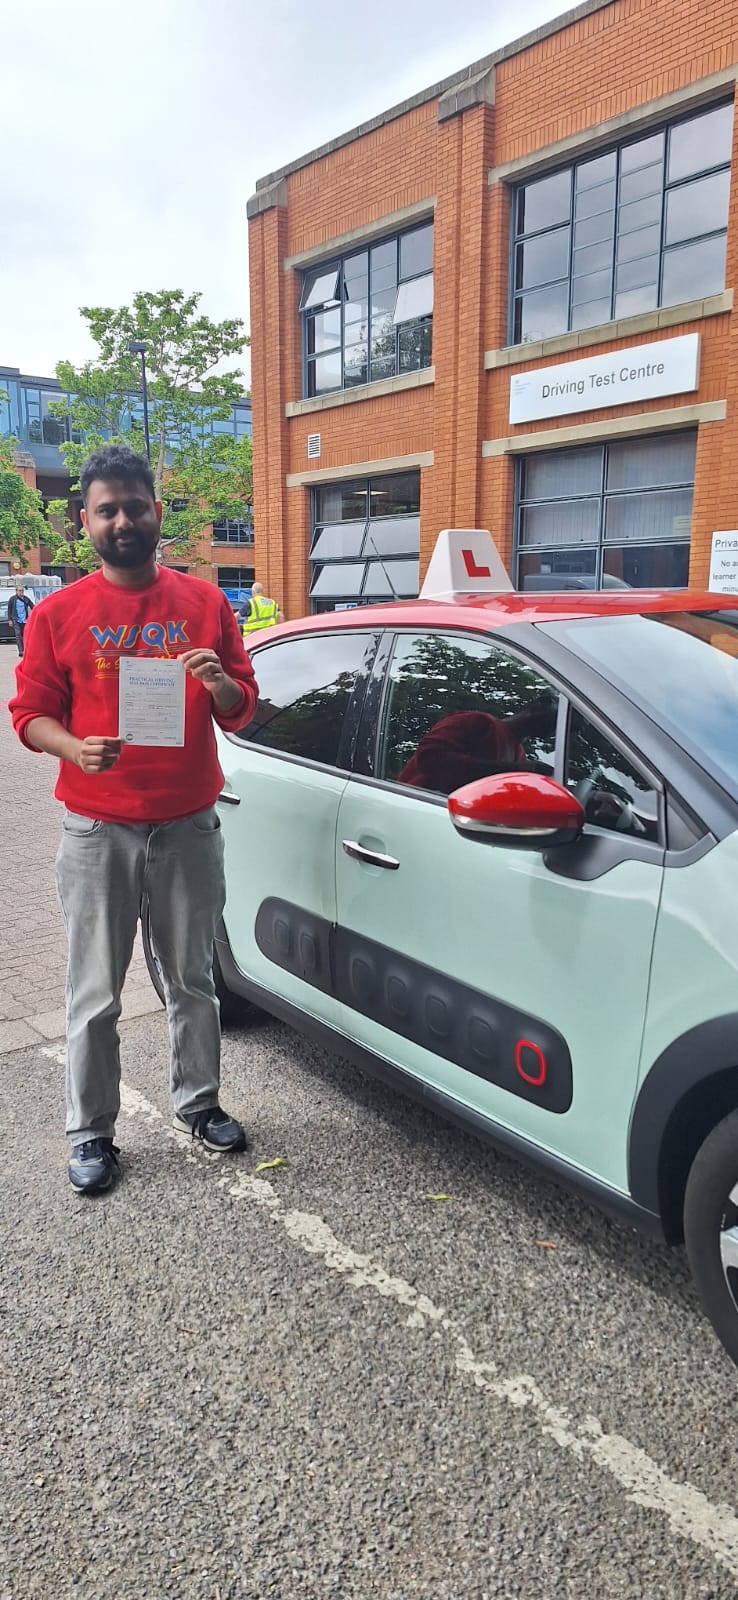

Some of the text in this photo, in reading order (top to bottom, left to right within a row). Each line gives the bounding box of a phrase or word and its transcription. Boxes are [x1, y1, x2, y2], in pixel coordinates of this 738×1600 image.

[541, 379, 584, 399] Driving
[589, 373, 615, 388] Test
[619, 362, 665, 383] Centre
[461, 549, 491, 577] L
[721, 560, 731, 568] No
[88, 619, 190, 657] WSQK
[95, 657, 111, 670] The
